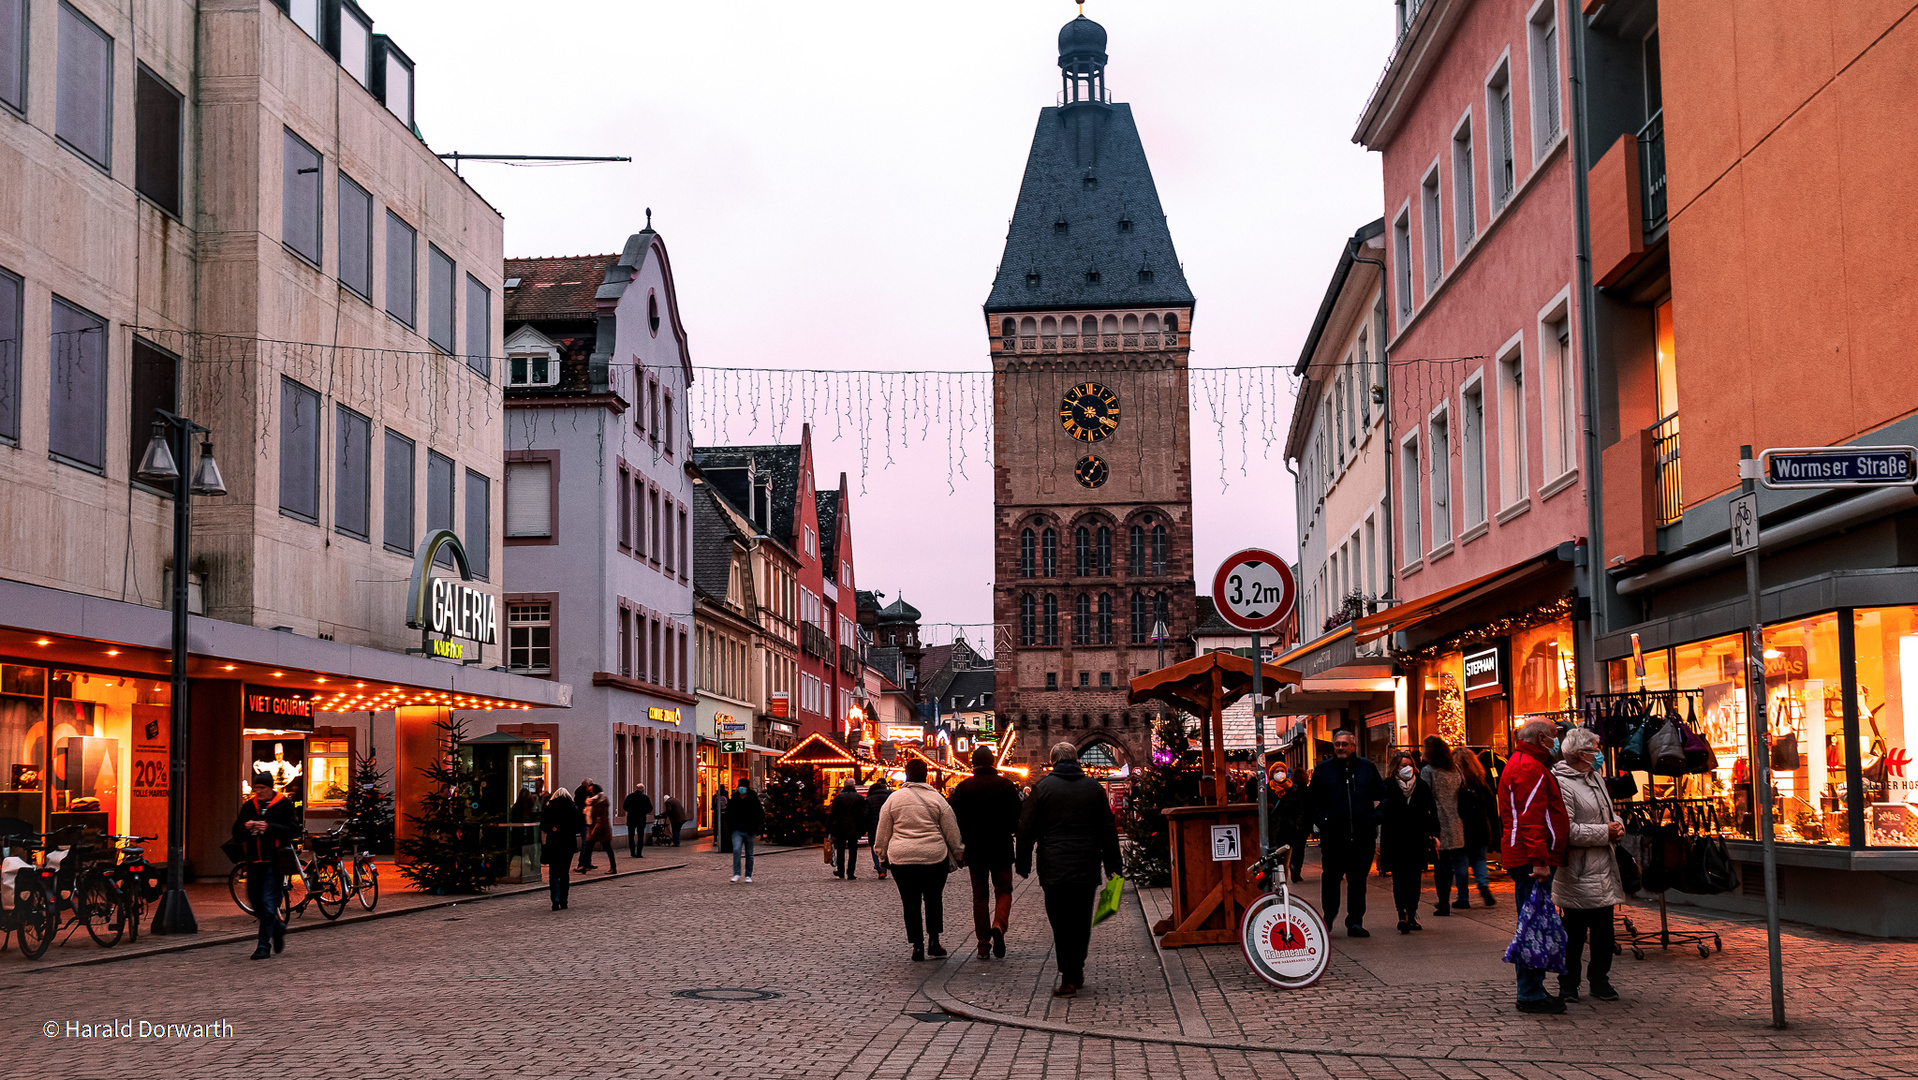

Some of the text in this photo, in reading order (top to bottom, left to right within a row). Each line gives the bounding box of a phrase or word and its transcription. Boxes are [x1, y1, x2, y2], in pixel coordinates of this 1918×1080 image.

[1776, 456, 1908, 478] Wormser Straße
[1229, 574, 1280, 607] 3,2m
[433, 577, 498, 644] GALERIA
[1466, 656, 1495, 677] STEPHAN
[249, 694, 315, 718] VIET GOURMET
[134, 759, 167, 787] 20%
[132, 789, 148, 797] TOLLE
[1261, 919, 1273, 945] SALSA
